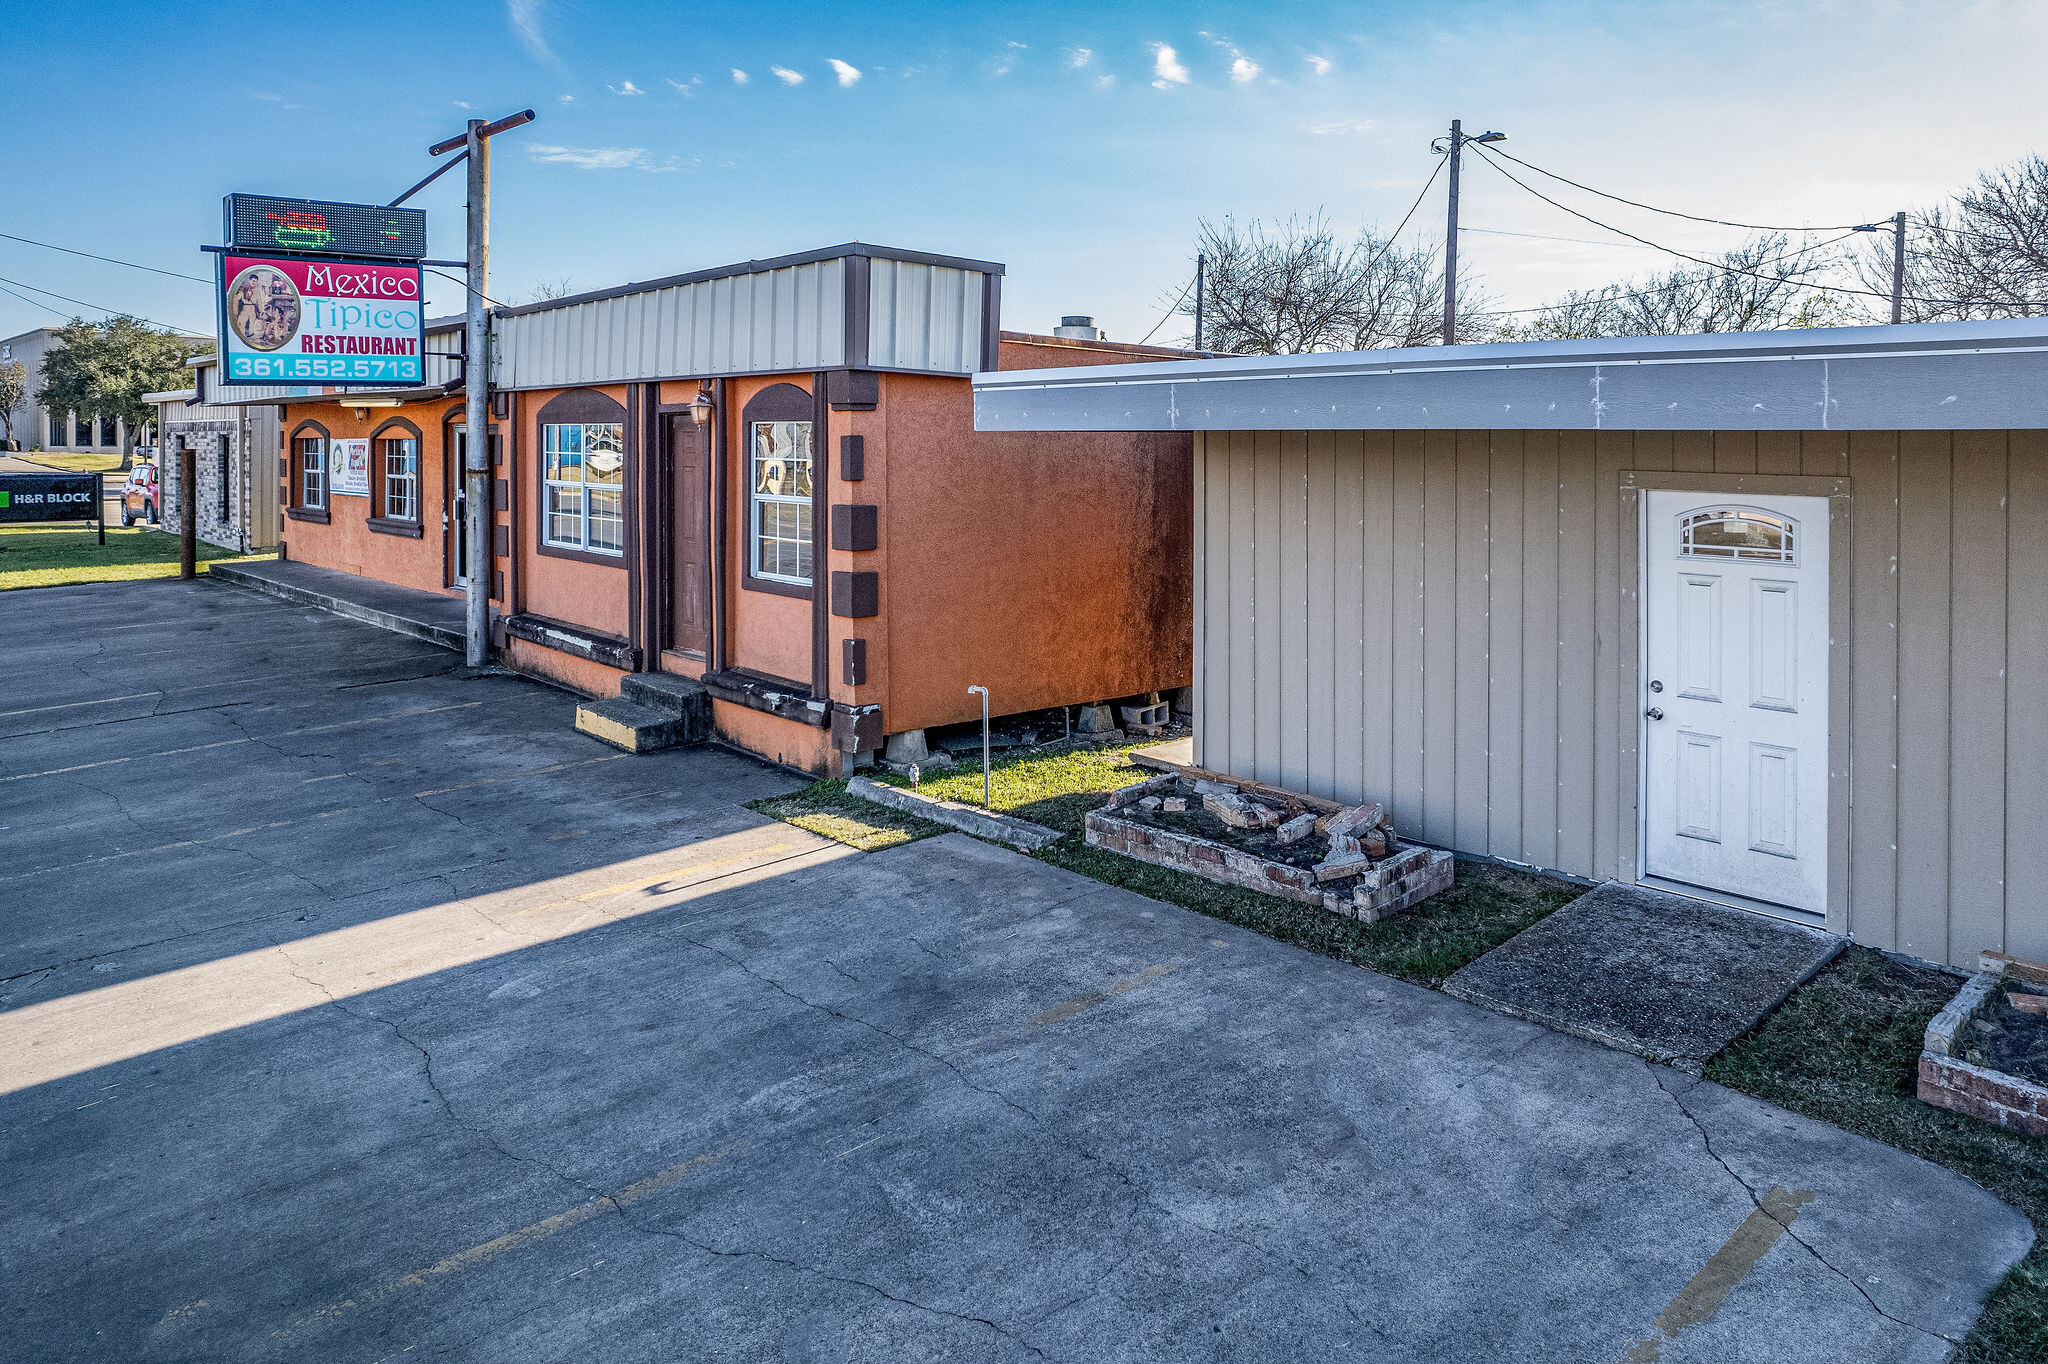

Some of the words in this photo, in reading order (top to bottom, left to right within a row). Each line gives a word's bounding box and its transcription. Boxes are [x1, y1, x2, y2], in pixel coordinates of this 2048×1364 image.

[304, 265, 418, 297] Mexico
[304, 297, 417, 331] Tipico
[301, 334, 417, 356] RESTAURANT
[234, 357, 417, 378] 361.552.5713
[14, 494, 44, 504] H&R
[47, 492, 91, 503] BLOCK
